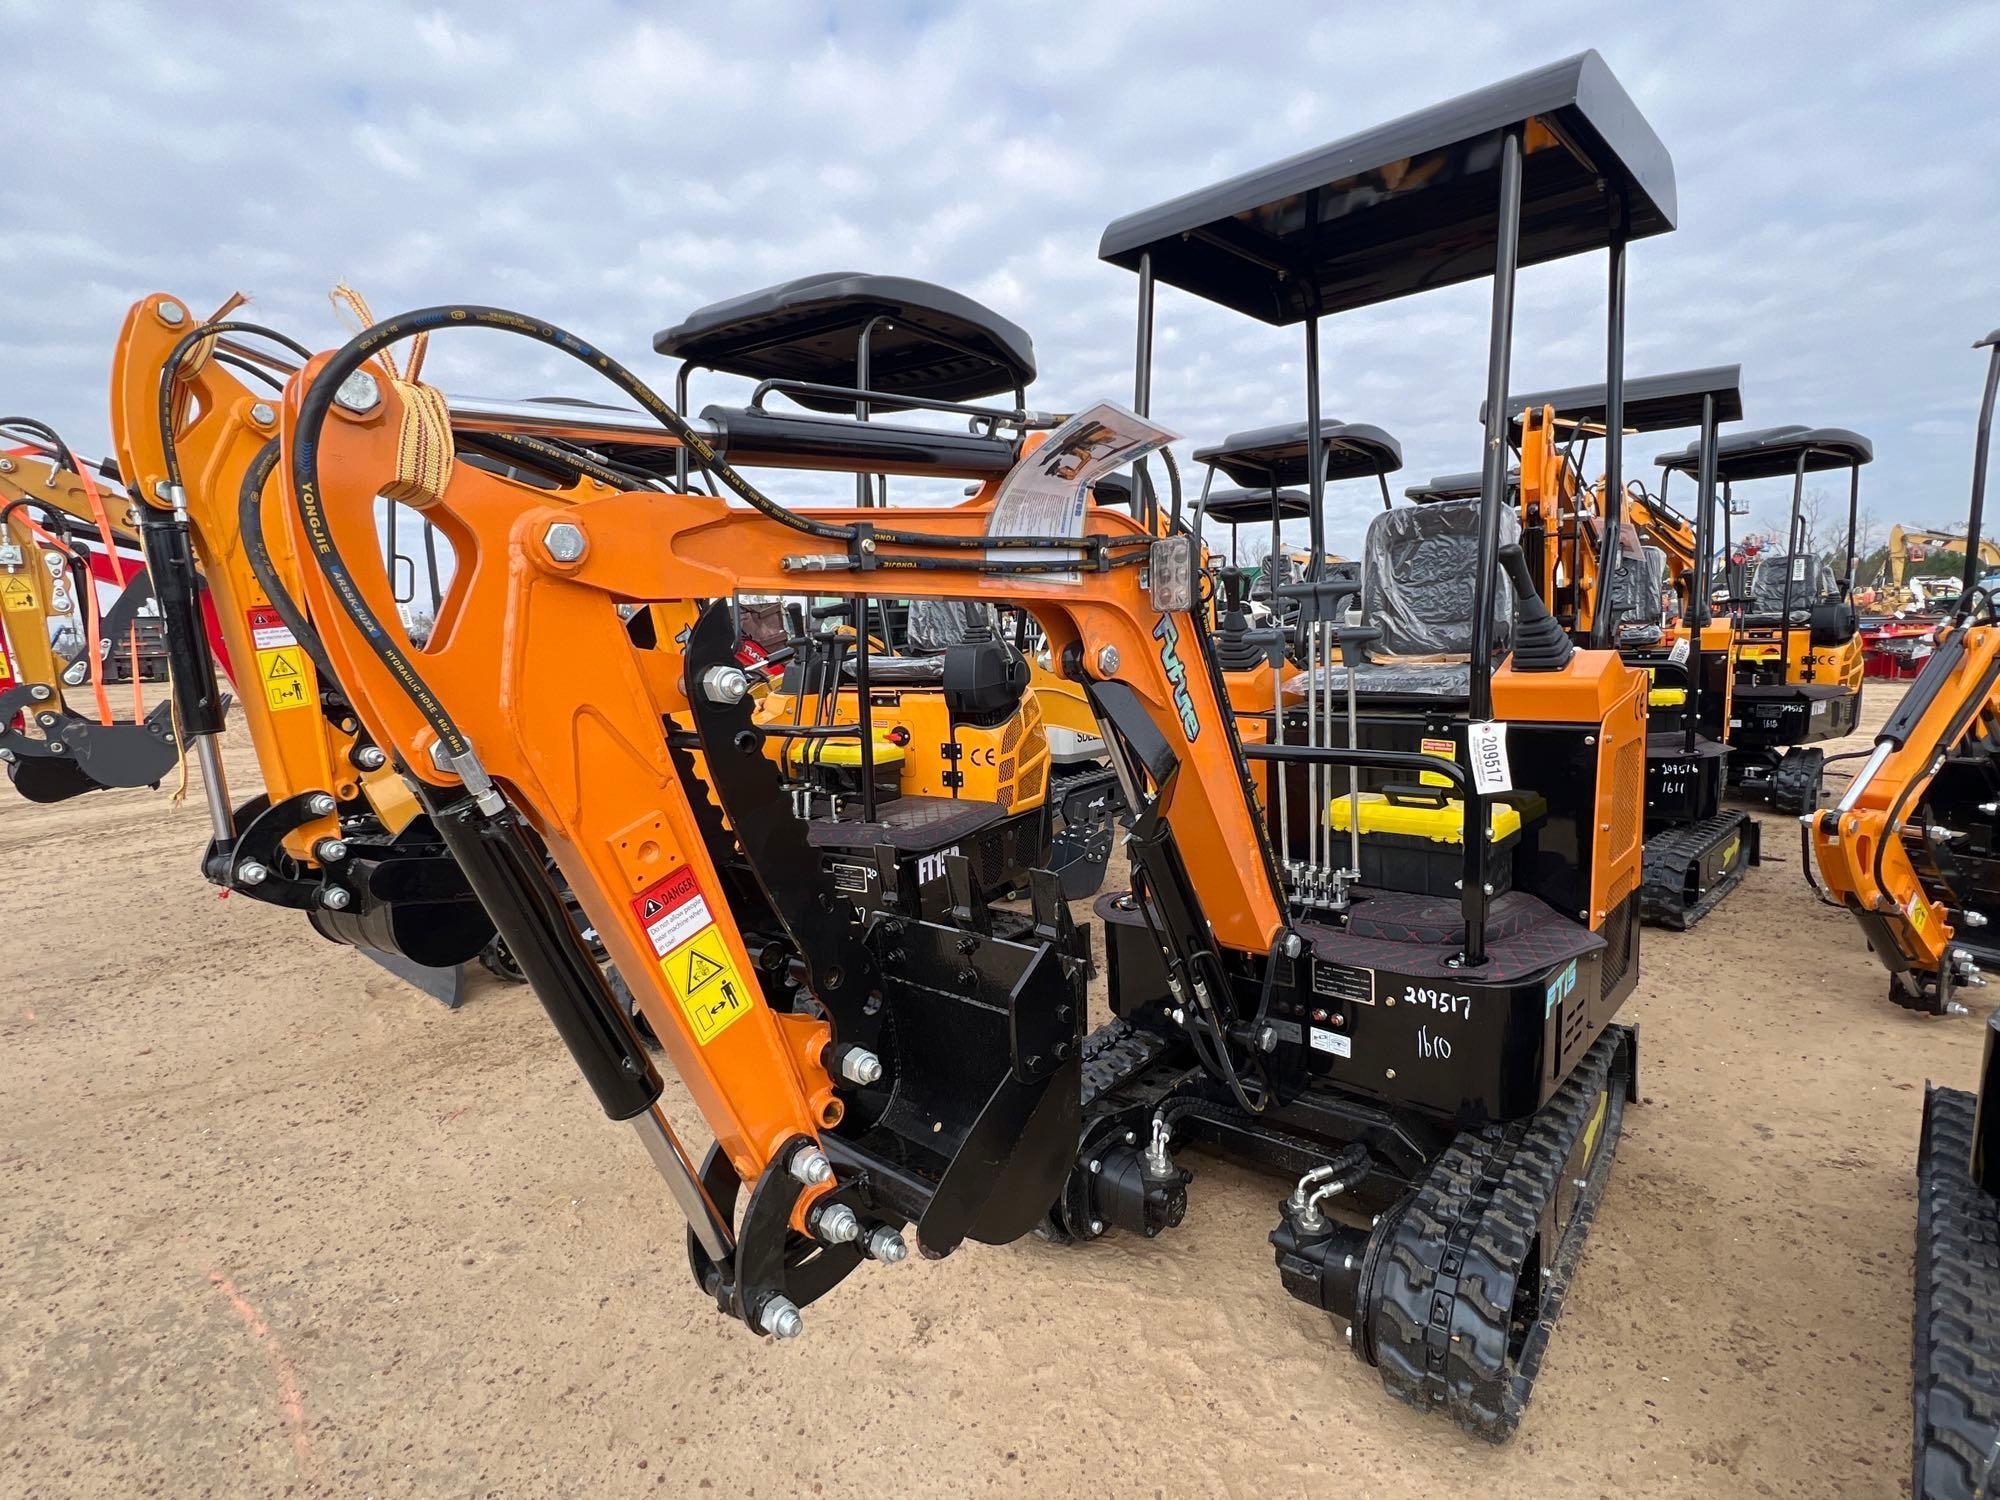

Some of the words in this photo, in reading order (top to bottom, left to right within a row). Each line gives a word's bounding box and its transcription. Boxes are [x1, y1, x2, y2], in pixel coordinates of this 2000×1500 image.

[302, 482, 331, 554] YONGJIE
[874, 533, 897, 543] YONG
[385, 649, 421, 693] HYDRAULIC
[419, 692, 437, 715] HOSE
[970, 747, 996, 767] CE
[1481, 736, 1504, 783] 209517
[1662, 782, 1685, 794] 1611
[918, 845, 960, 885] FT15
[661, 877, 696, 906] DANGER
[650, 926, 660, 936] Do
[660, 919, 669, 930] not
[1403, 986, 1471, 1020] 209517
[1417, 1025, 1451, 1059] 1610
